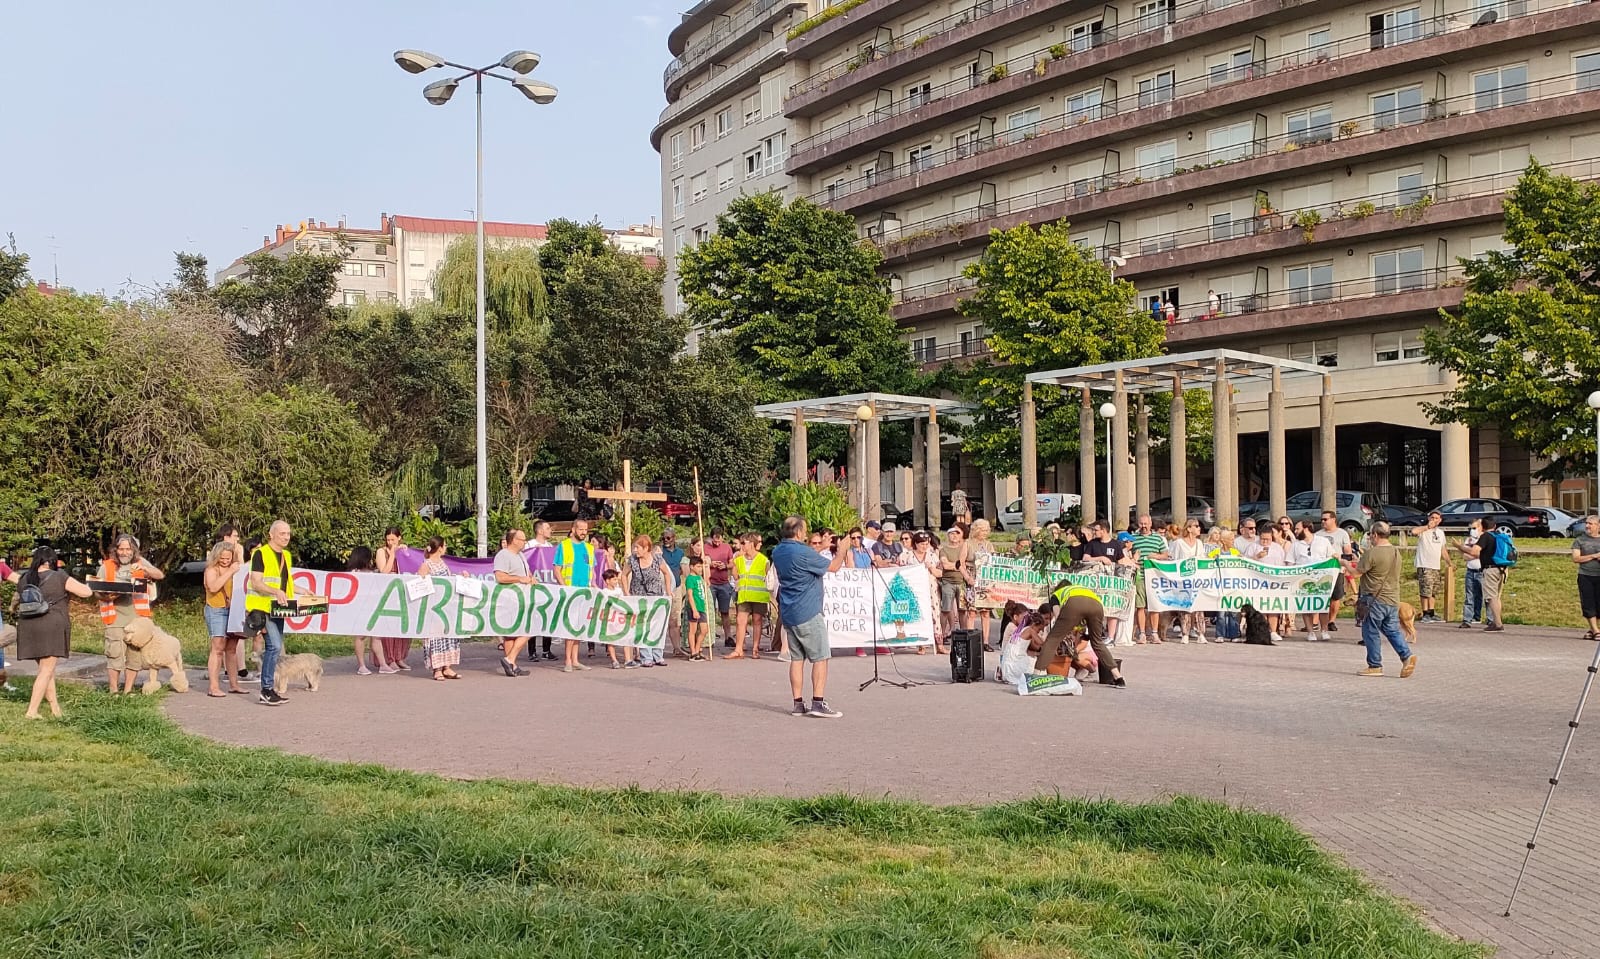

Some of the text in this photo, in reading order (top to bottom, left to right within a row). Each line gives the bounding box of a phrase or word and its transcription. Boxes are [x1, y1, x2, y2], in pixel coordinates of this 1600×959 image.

[981, 566, 1025, 582] DEFENSA
[1263, 567, 1277, 576] en
[1151, 577, 1291, 590] SEN BIODIVERSIDADE
[824, 586, 864, 598] ARQUE
[1260, 596, 1289, 611] HAI
[366, 576, 670, 646] ARBORICIDIO
